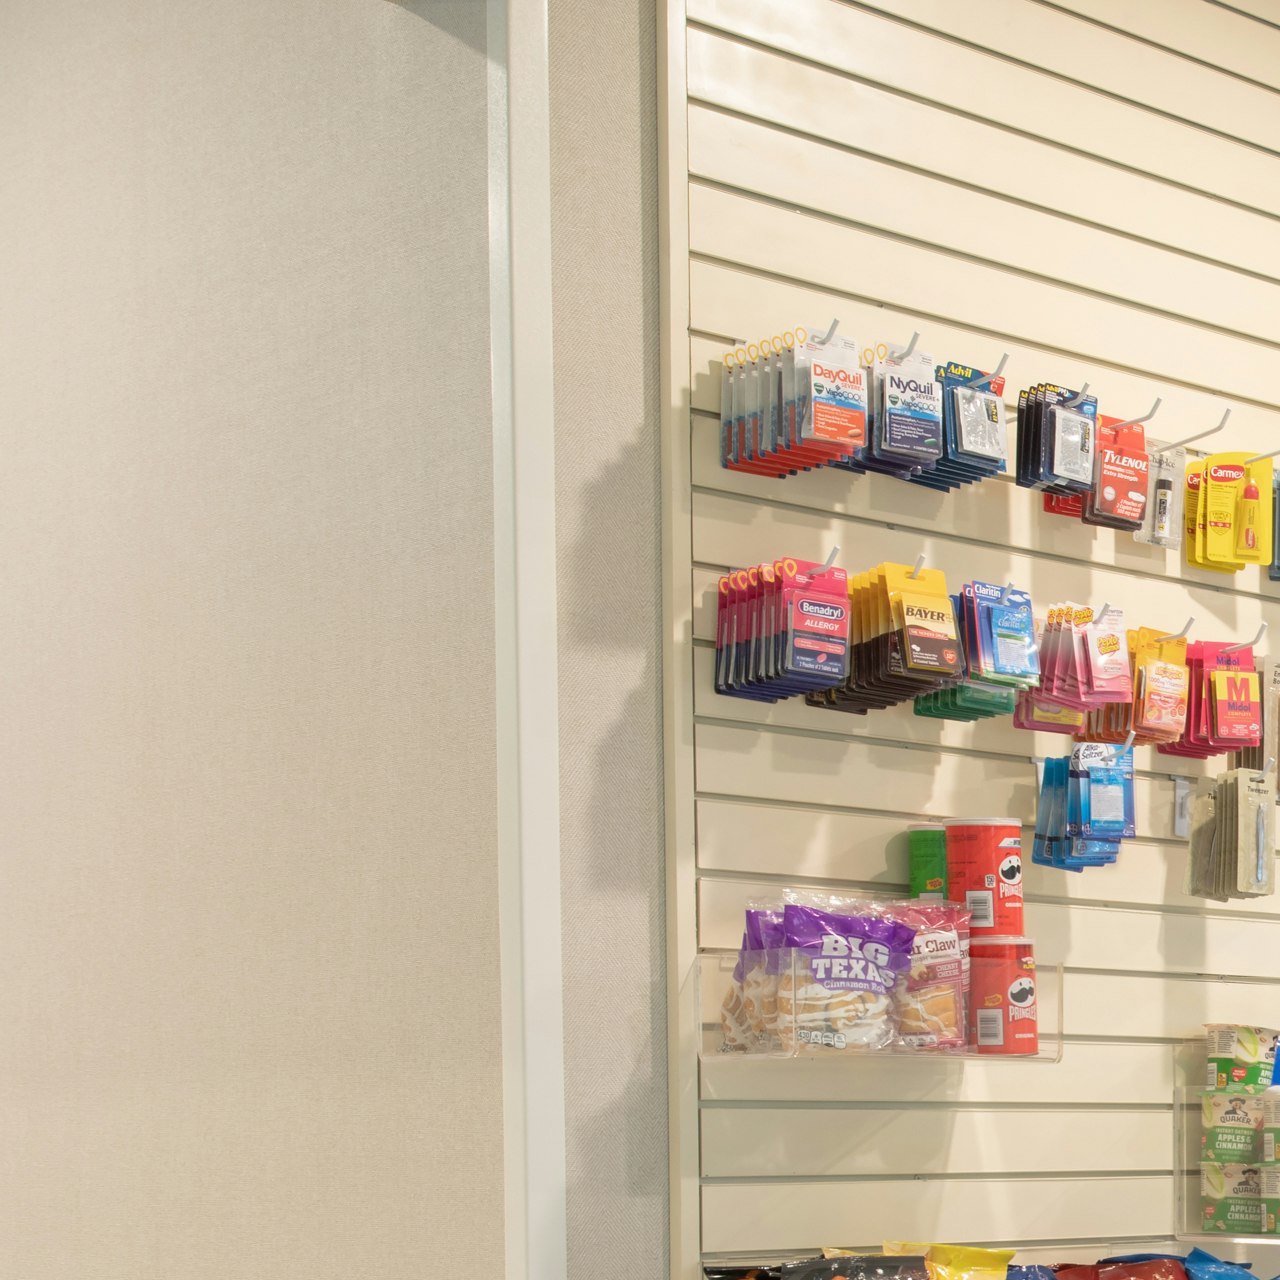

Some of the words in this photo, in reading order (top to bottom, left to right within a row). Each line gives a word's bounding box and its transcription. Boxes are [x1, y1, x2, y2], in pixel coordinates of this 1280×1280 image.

[813, 364, 862, 386] DayQuil
[949, 364, 973, 378] Advil
[890, 376, 933, 395] NyQuil
[1103, 449, 1149, 471] TYLENOL
[1210, 466, 1244, 479] Carmex
[974, 583, 1001, 598] Claritin
[802, 603, 841, 619] Benadryl
[906, 607, 945, 621] BAYER
[804, 619, 840, 631] ALLERGY
[1227, 702, 1250, 711] Midol
[822, 933, 891, 966] BIG
[924, 939, 956, 955] Claw
[812, 957, 895, 987] TEXAS
[823, 980, 868, 991] Cinnamon
[1219, 1115, 1251, 1125] QUAKER
[1217, 1134, 1245, 1142] APPLES
